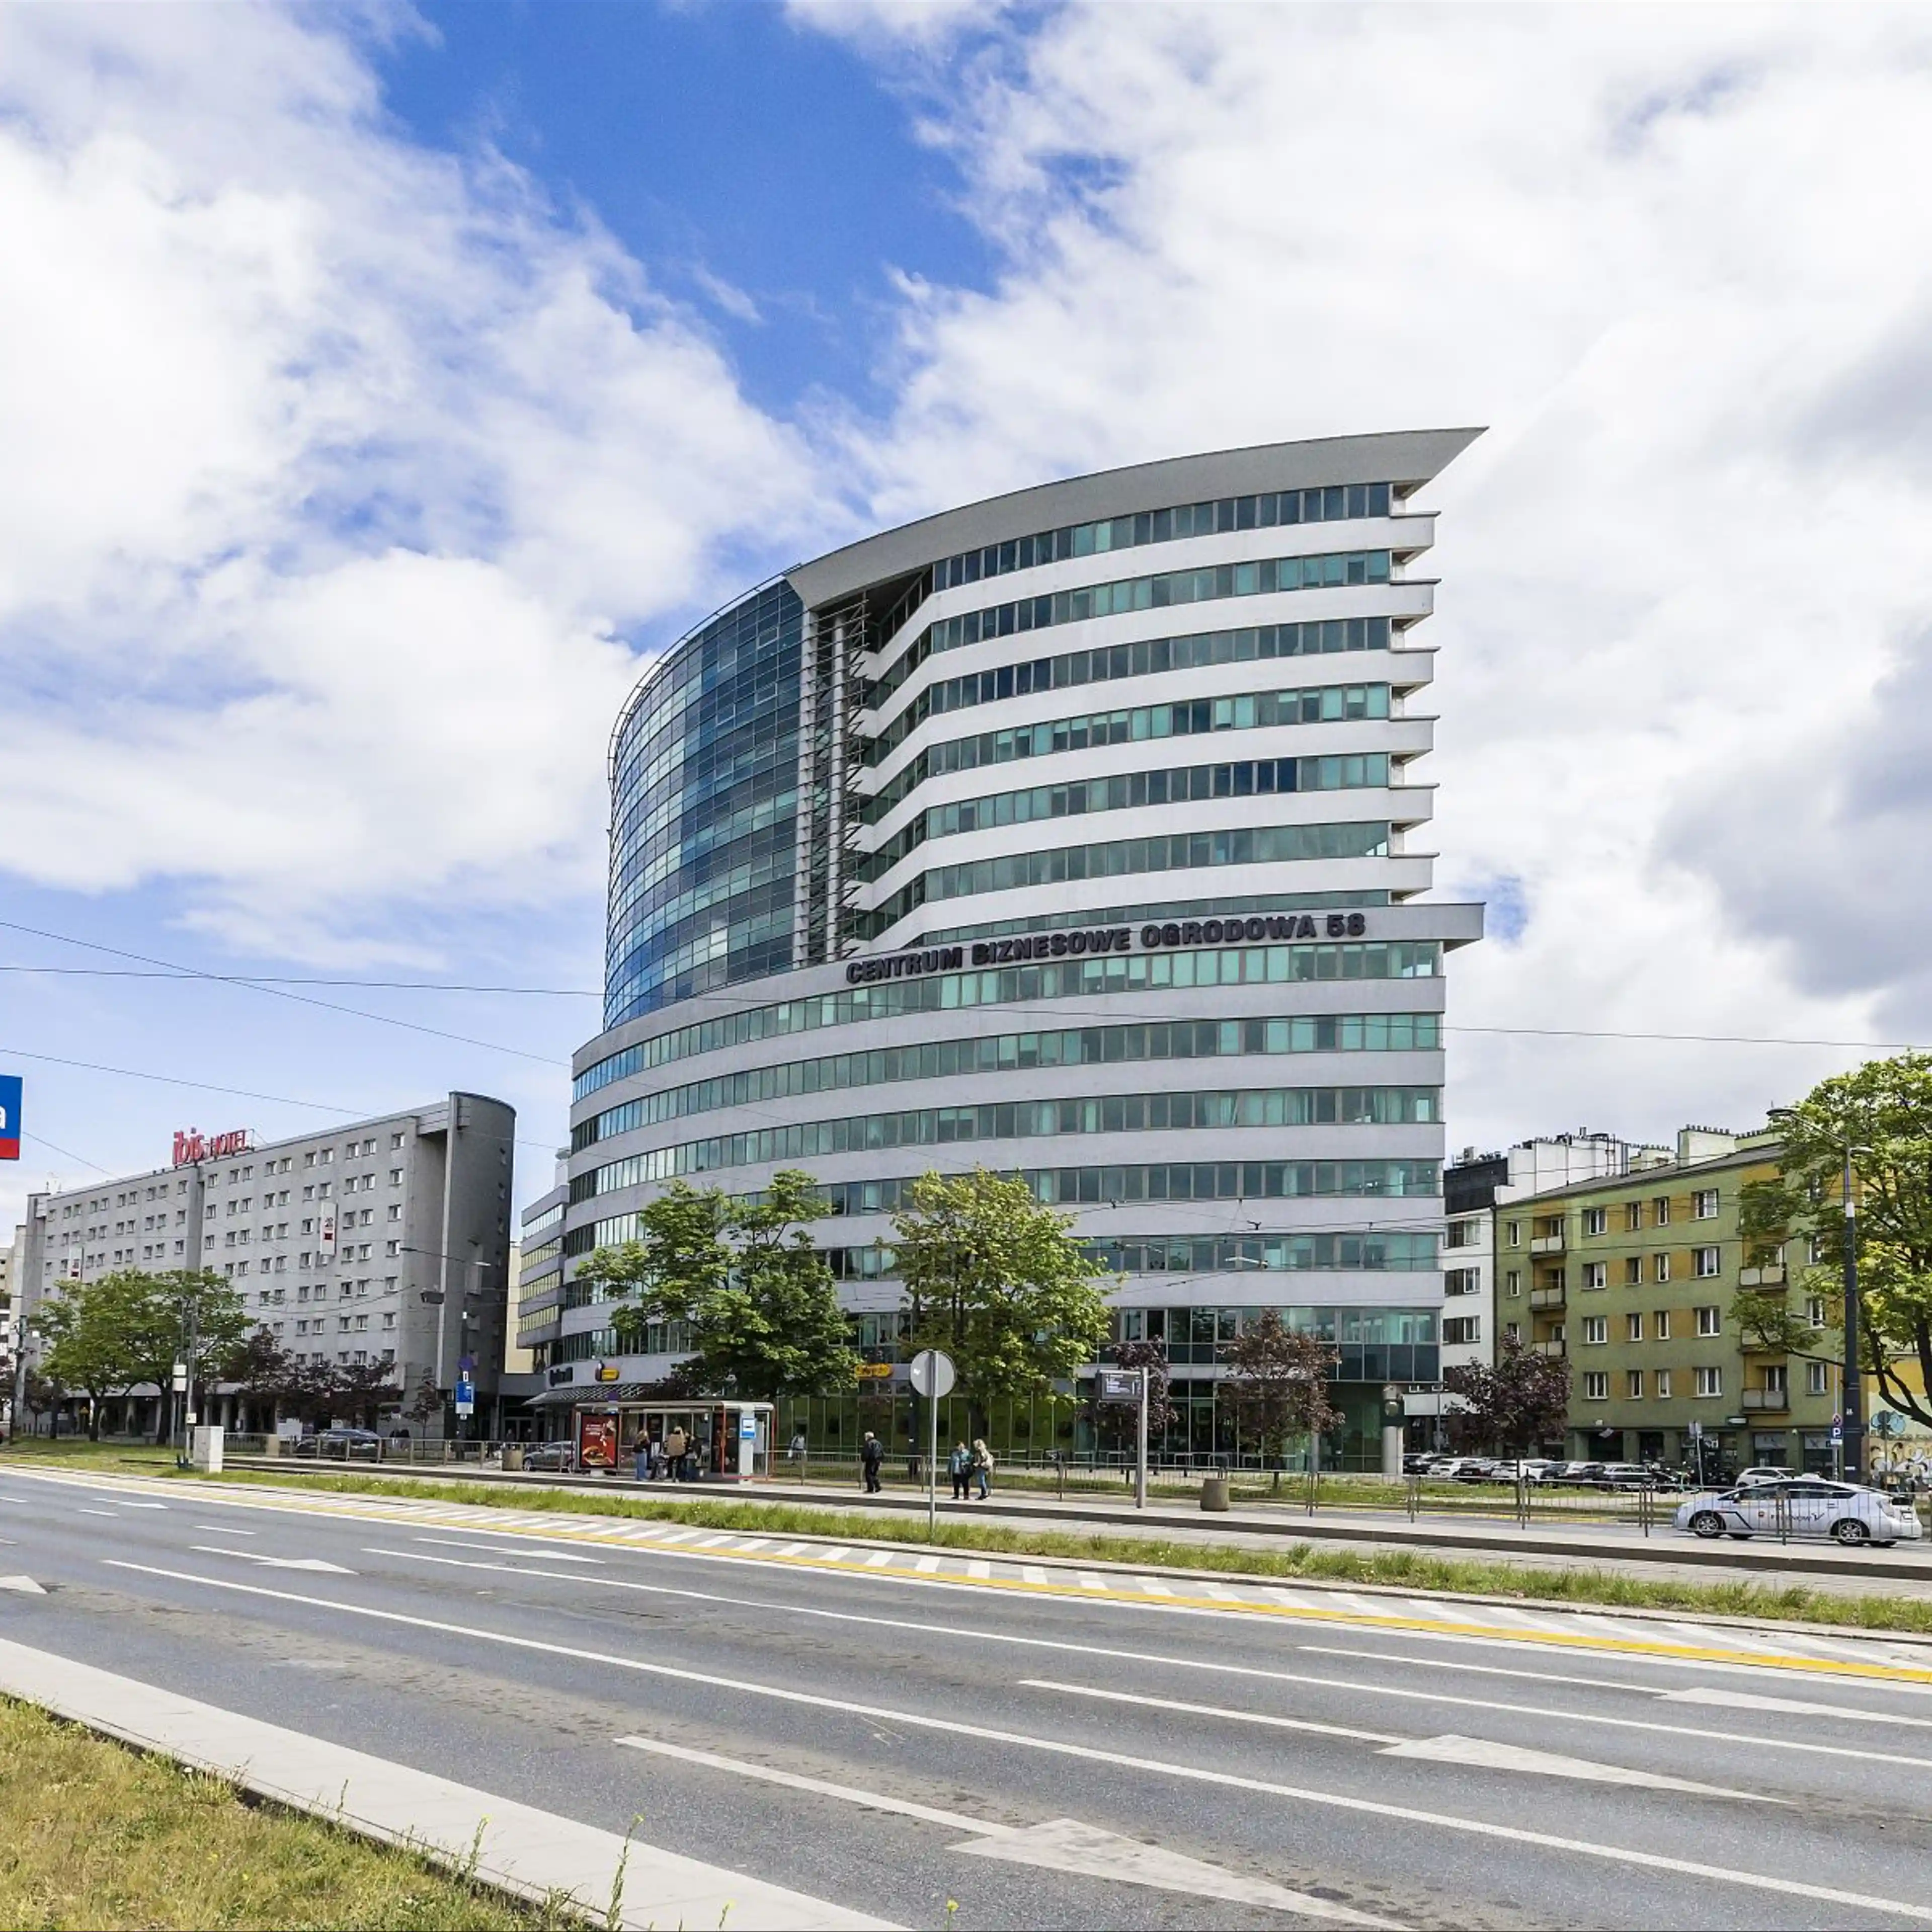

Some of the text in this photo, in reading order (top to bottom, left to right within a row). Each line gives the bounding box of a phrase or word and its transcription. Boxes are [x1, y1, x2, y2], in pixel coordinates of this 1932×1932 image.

[846, 912, 1366, 984] CENTRUM BIZNESOWE OGRODOWA 58
[173, 1128, 205, 1165] ibis
[1833, 1427, 1841, 1438] P
